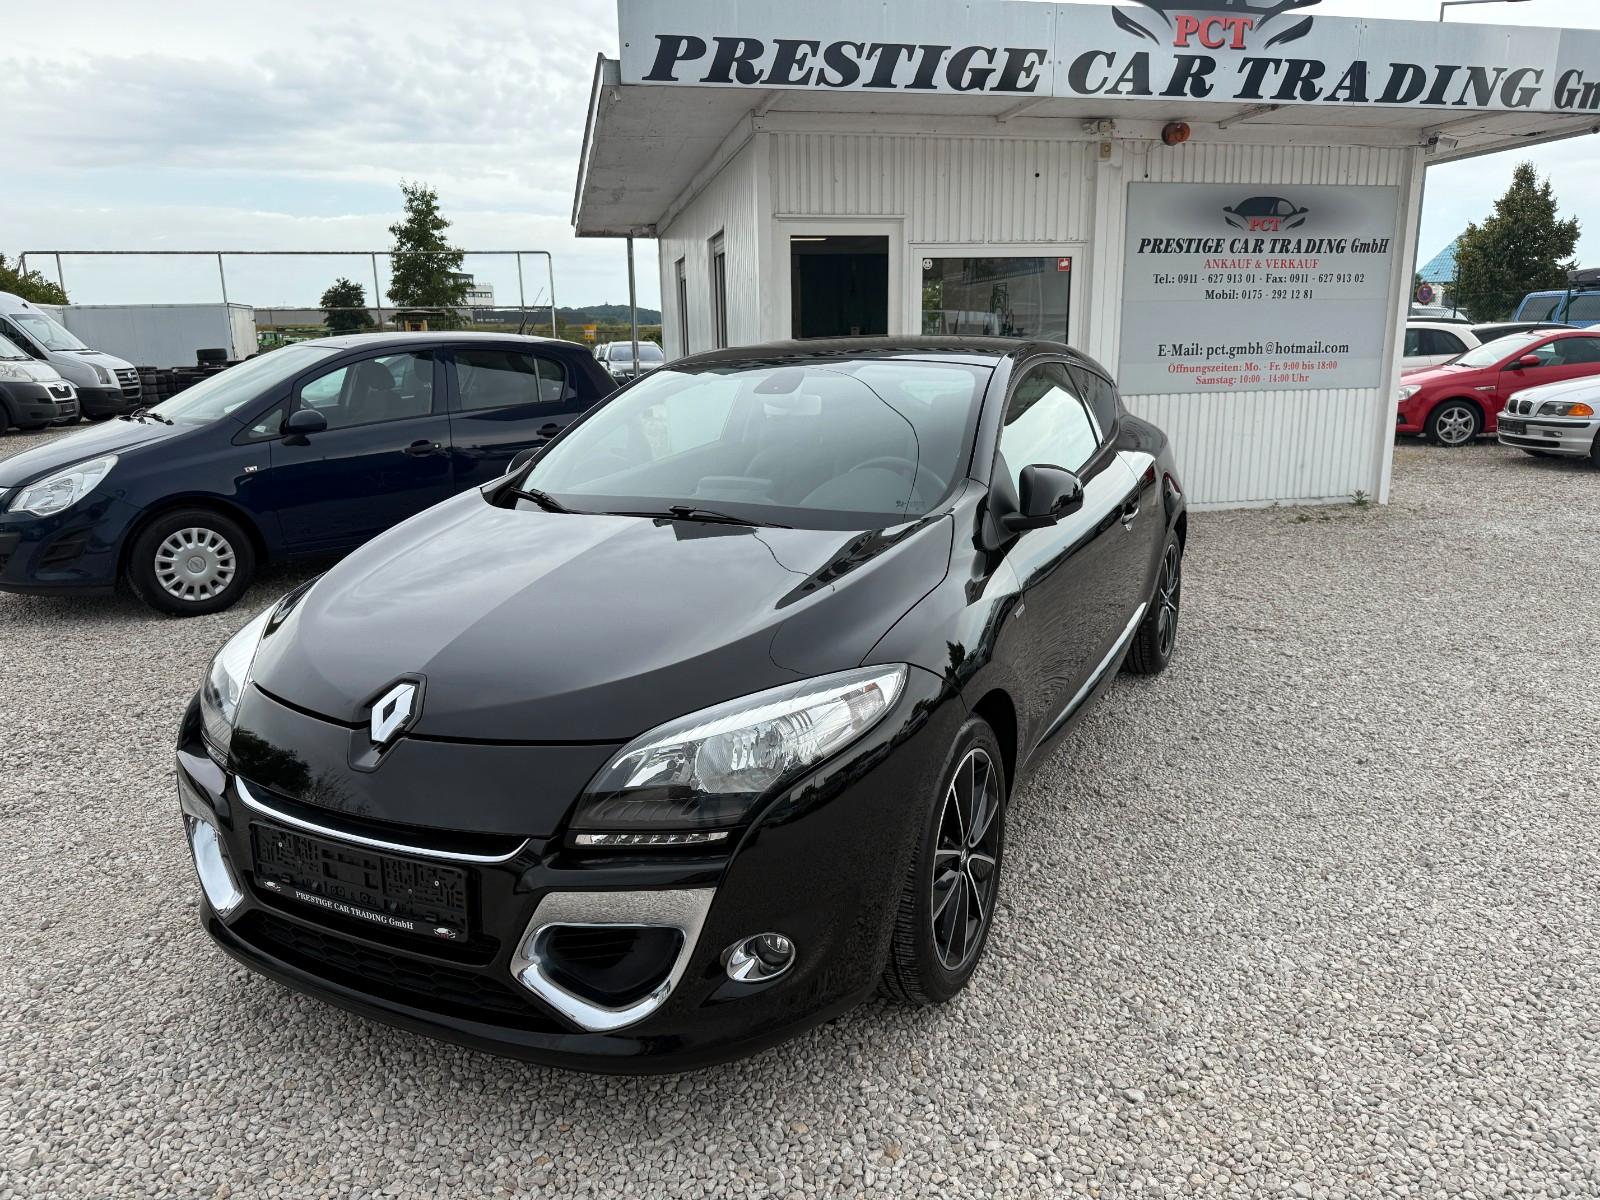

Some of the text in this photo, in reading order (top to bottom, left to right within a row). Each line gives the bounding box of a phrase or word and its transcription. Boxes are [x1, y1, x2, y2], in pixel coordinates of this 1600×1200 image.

[1172, 15, 1254, 50] PCT
[641, 34, 1048, 93] PRESTIGE
[1067, 49, 1213, 98] CAR
[1233, 57, 1543, 109] TRADING
[1249, 217, 1282, 233] PCT
[1137, 237, 1390, 255] PRESTIGE CAR TRADING GmbH
[1204, 258, 1320, 270] ANKAUF & VERKAUF
[1152, 273, 1176, 285] Tel.:
[1177, 273, 1198, 285] 0911
[1207, 273, 1225, 284] 627
[1226, 273, 1244, 284] 913
[1245, 273, 1256, 284] 01
[1265, 273, 1288, 285] Fax:
[1289, 273, 1309, 284] 0911
[1318, 273, 1334, 284] 627
[1336, 273, 1352, 283] 913
[1354, 273, 1365, 283] 02
[1204, 289, 1239, 300] Mobil:
[1241, 289, 1263, 300] 0175
[1271, 289, 1288, 300] 292
[1290, 289, 1302, 300] 12
[1303, 289, 1314, 299] 81
[1157, 340, 1350, 360] E-Mail: pct.gmbh@hotmail.com
[1168, 362, 1242, 376] Öffnungszeiten:
[1244, 362, 1262, 372] Mo.
[1269, 361, 1281, 371] Fr.
[1283, 361, 1300, 371] 9:00
[1302, 360, 1315, 370] bis
[1317, 360, 1338, 370] 18:00
[1195, 375, 1237, 387] Samstag:
[1239, 374, 1261, 384] 10:00
[1269, 373, 1290, 383] 14:00
[1292, 372, 1310, 382] Uhr
[295, 890, 414, 930] PRESTIGE CAR TRADING GmbH
